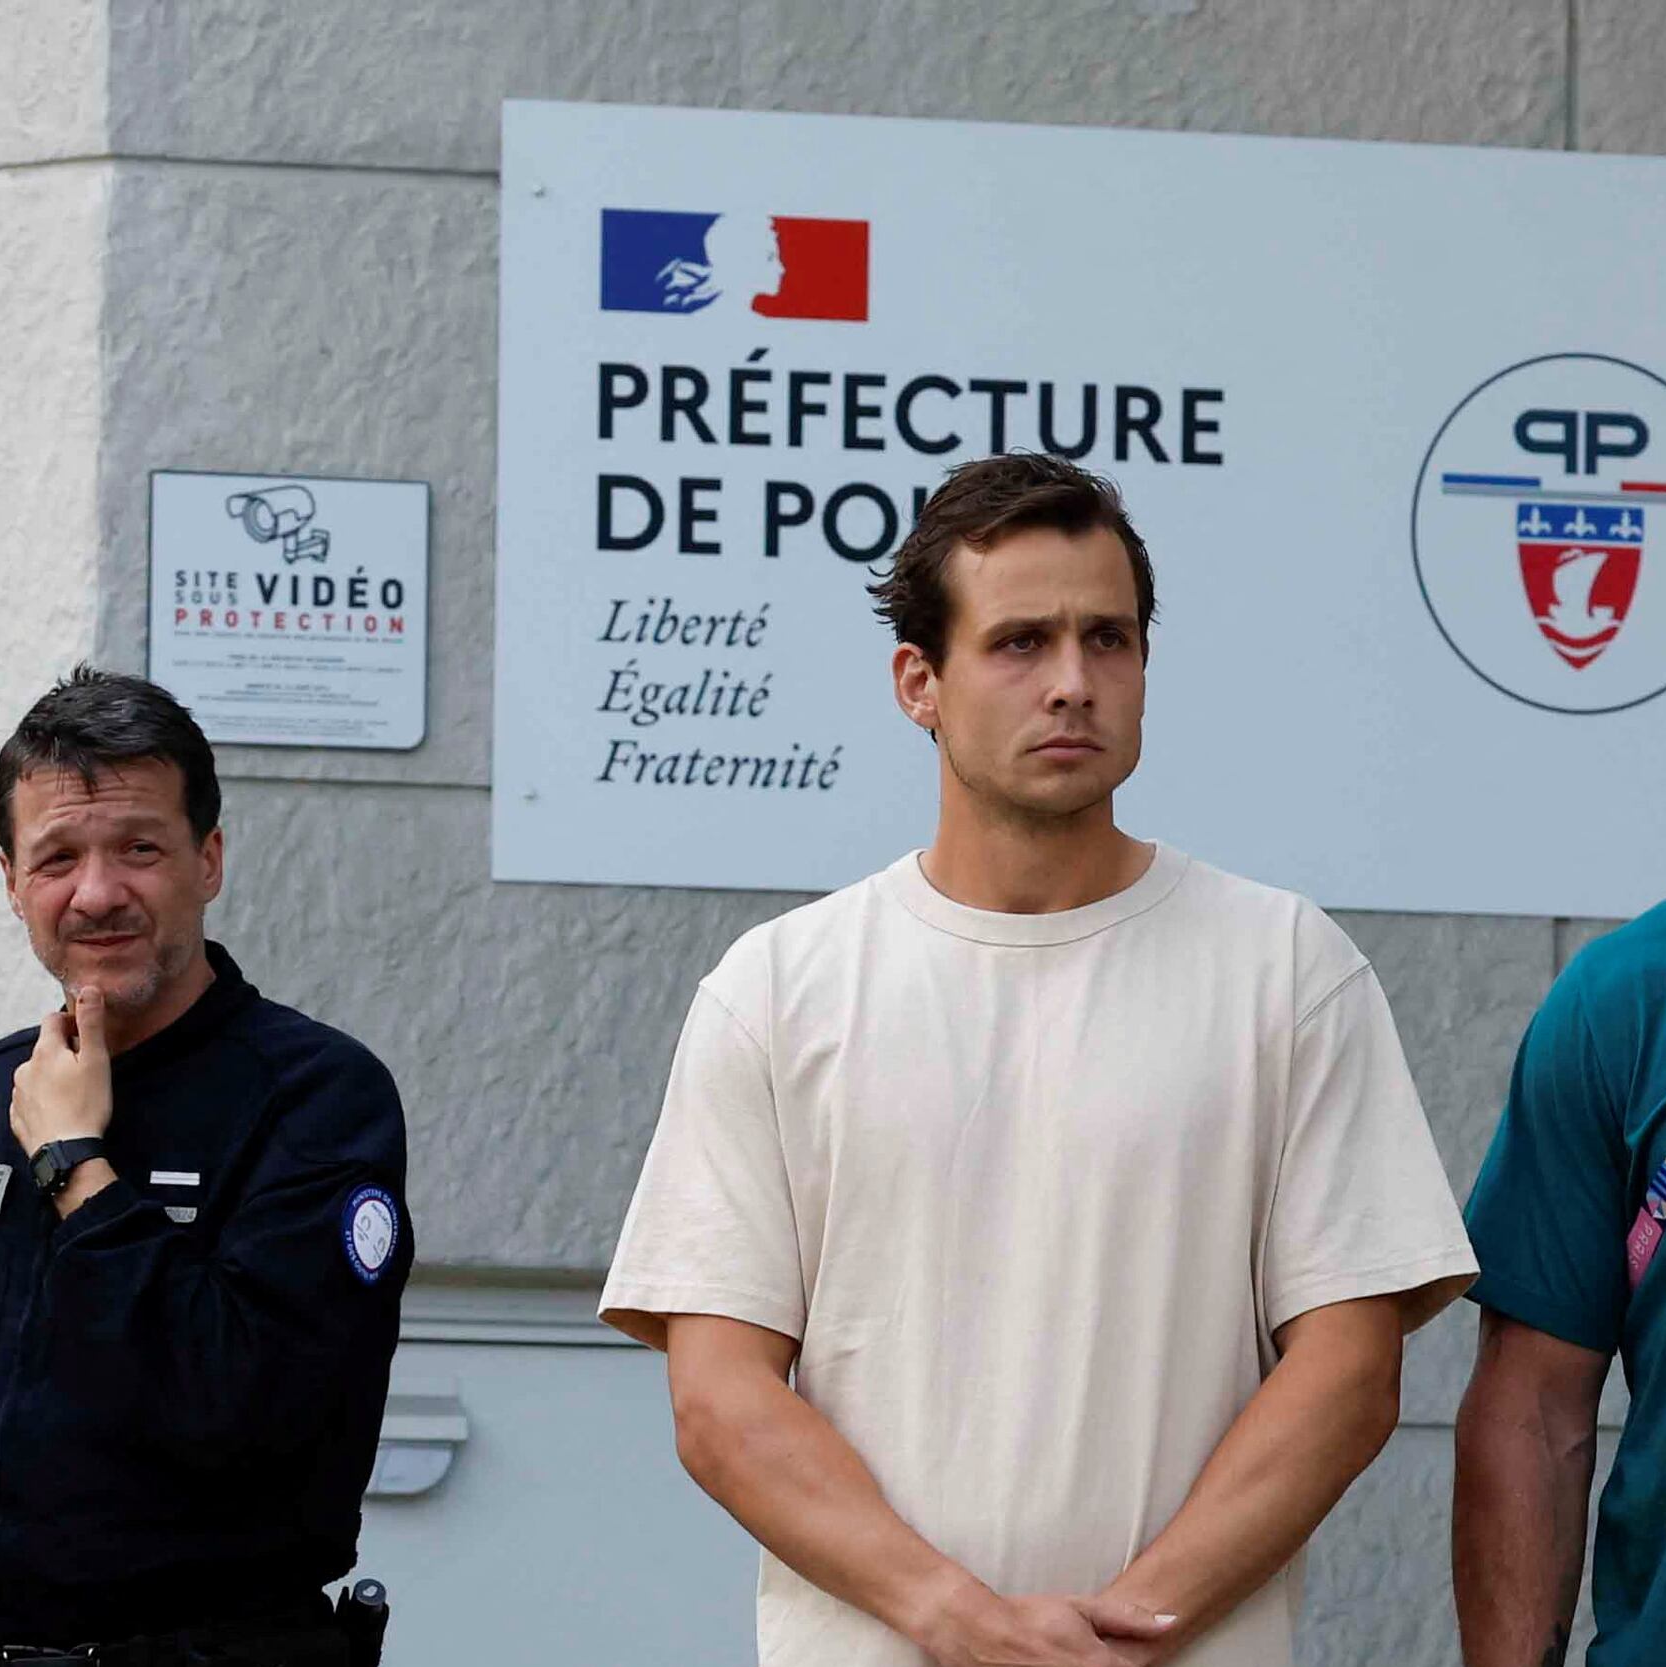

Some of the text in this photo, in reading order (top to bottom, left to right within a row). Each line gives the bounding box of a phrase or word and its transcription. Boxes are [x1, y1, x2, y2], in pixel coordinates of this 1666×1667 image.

[598, 349, 1224, 465] PRÉFECTURE
[597, 475, 721, 555] DE
[175, 570, 238, 589] SITE
[256, 565, 404, 610] VIDÉO
[175, 608, 403, 634] PROTECTION
[598, 599, 770, 649] Liberté
[598, 666, 772, 721] Égalité
[598, 739, 842, 791] Fraternité
